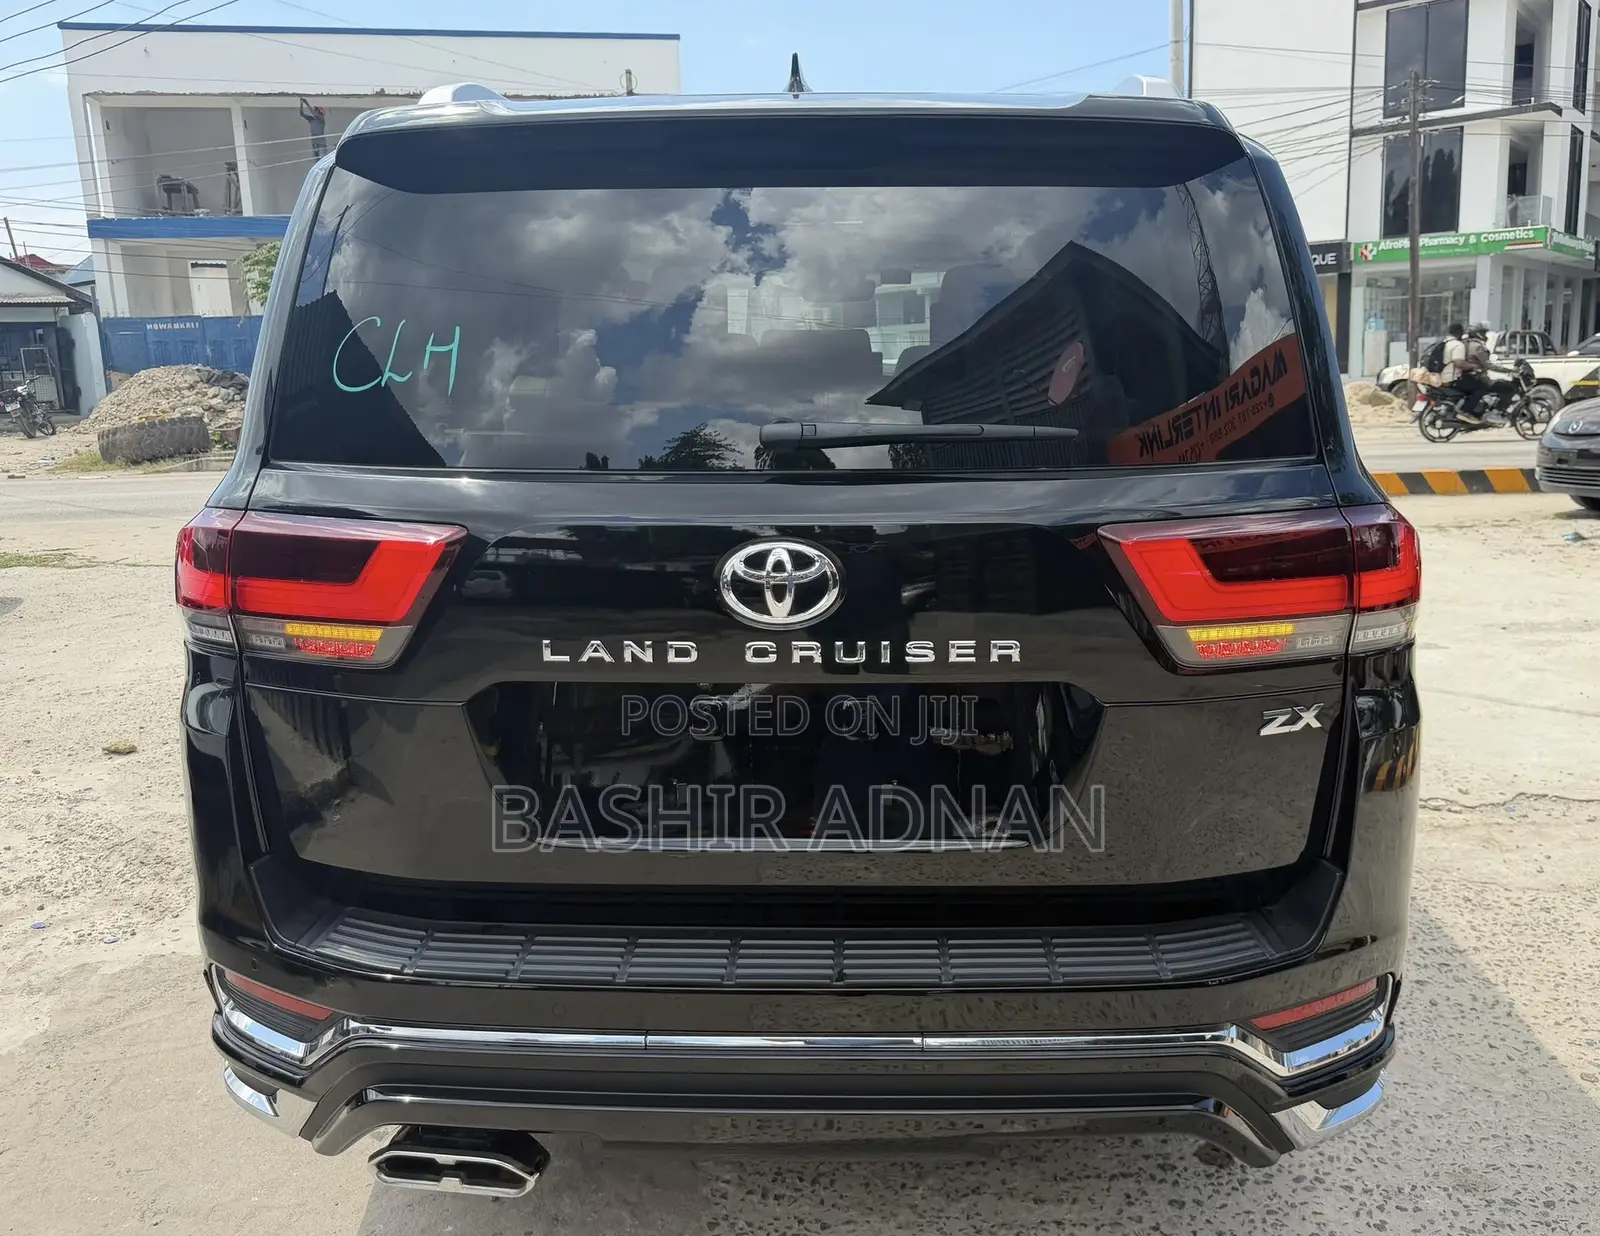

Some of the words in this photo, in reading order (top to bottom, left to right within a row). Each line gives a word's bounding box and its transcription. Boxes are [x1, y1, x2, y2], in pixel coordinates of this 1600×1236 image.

[1419, 235, 1465, 247] Pharmacy
[1468, 234, 1477, 244] &
[1480, 229, 1535, 243] Cosmetics
[333, 316, 460, 396] CLH
[542, 639, 699, 664] LAND
[744, 639, 1022, 664] CRUISER
[1259, 702, 1325, 736] ZX
